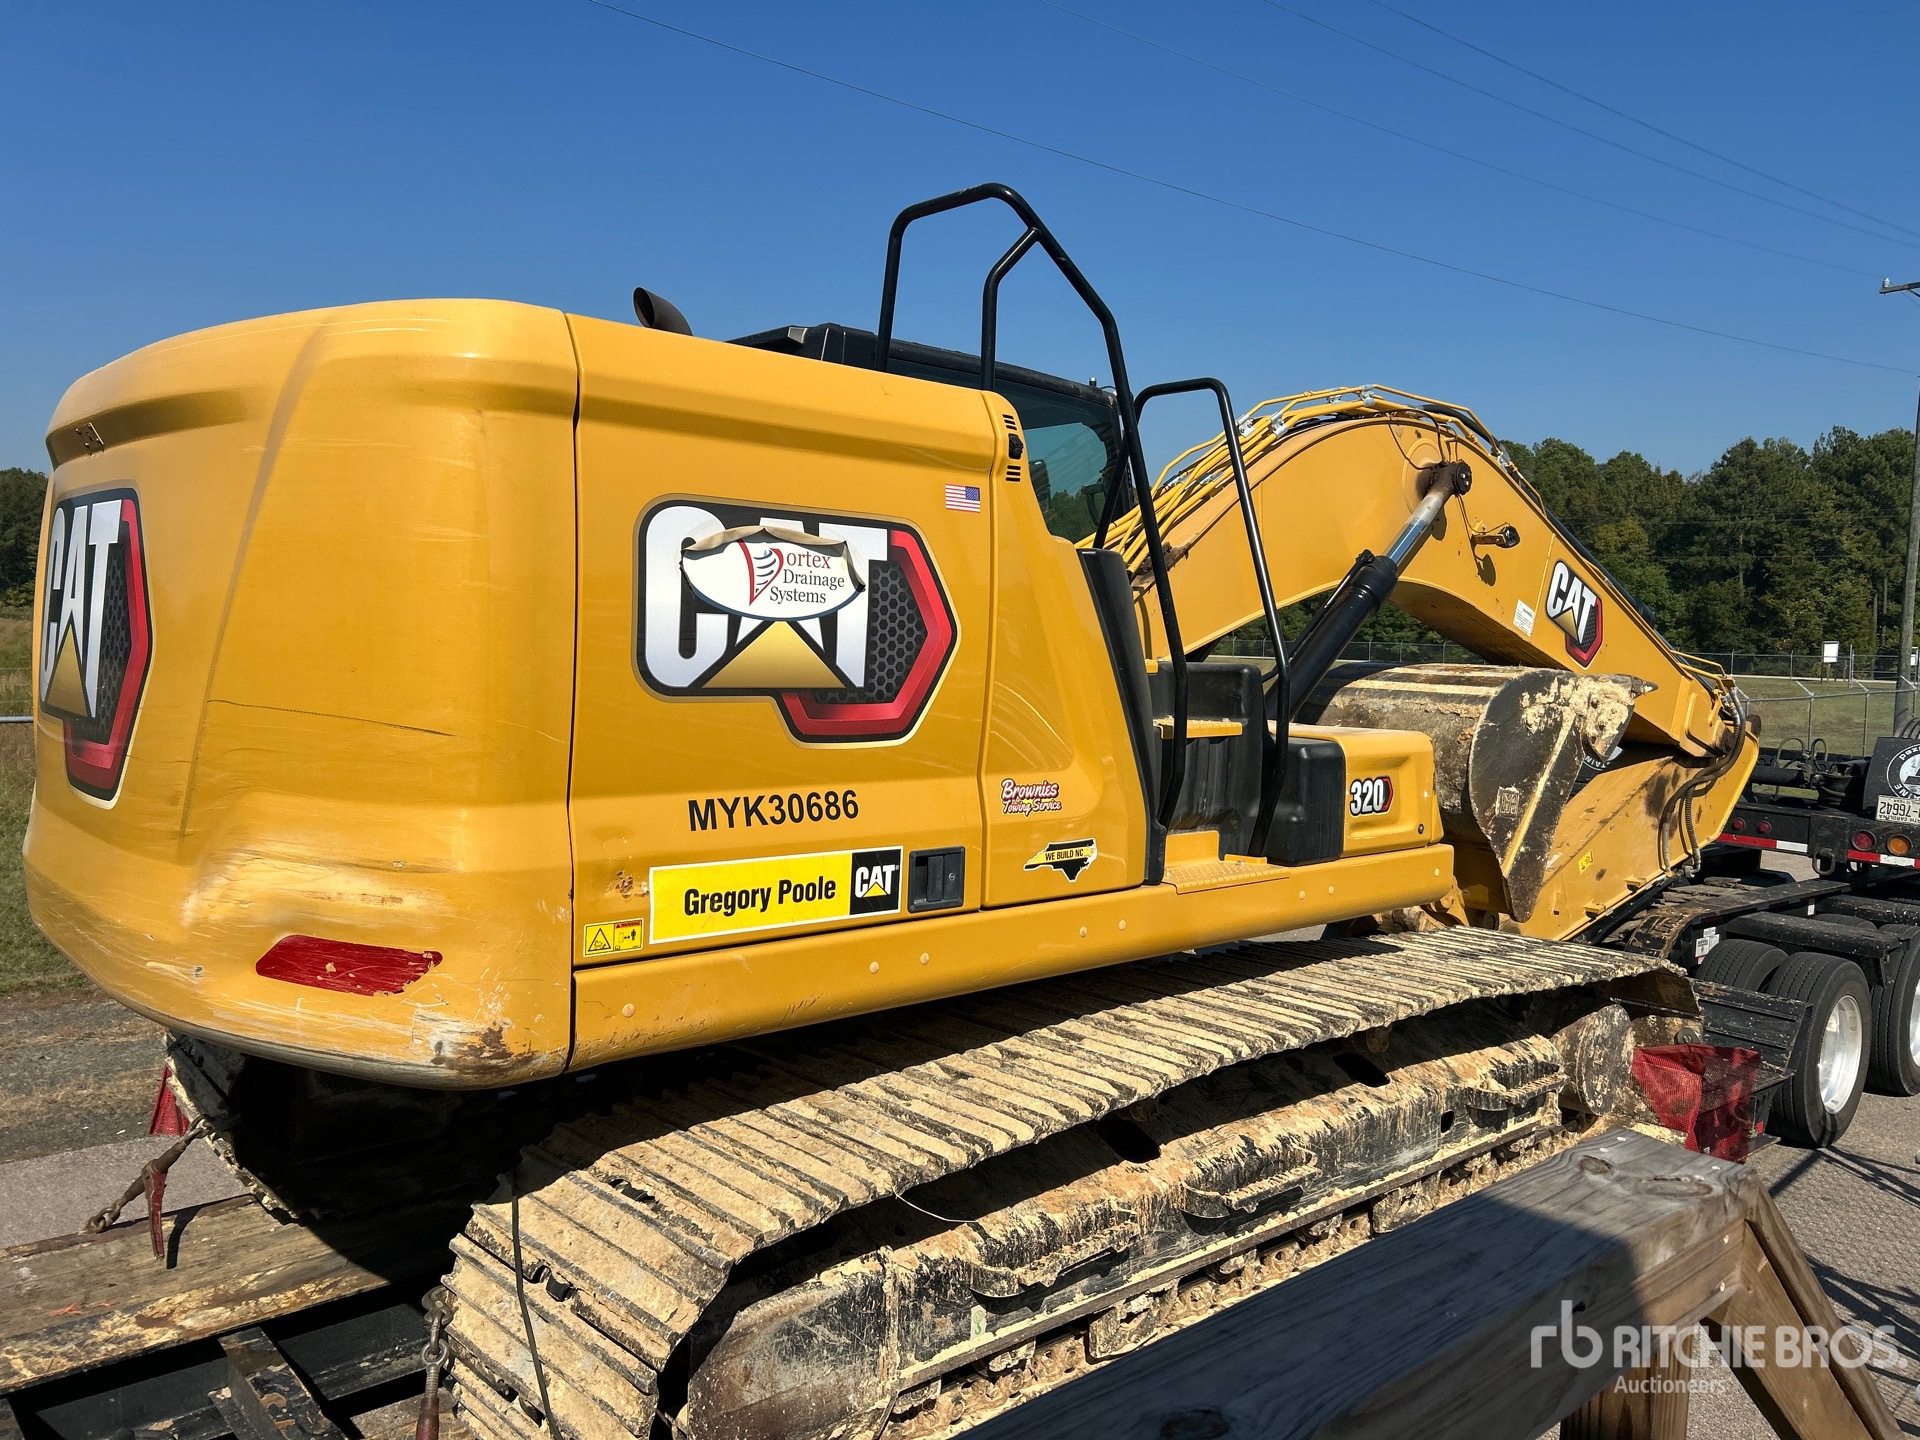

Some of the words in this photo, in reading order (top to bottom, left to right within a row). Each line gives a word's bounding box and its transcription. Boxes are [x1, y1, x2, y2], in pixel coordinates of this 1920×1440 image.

[783, 569, 845, 591] Drainage
[40, 499, 122, 718] CAT
[770, 586, 826, 604] Systems
[1546, 562, 1597, 643] CAT
[688, 790, 859, 832] MYK30686
[1032, 798, 1061, 812] Service
[1350, 778, 1384, 815] 320
[1880, 801, 1920, 817] -76642
[1045, 852, 1055, 861] WE
[1056, 850, 1074, 860] BUILD
[1075, 848, 1084, 858] NC
[684, 886, 772, 917] Gregory
[778, 876, 836, 904] Poole
[854, 864, 896, 899] CAT
